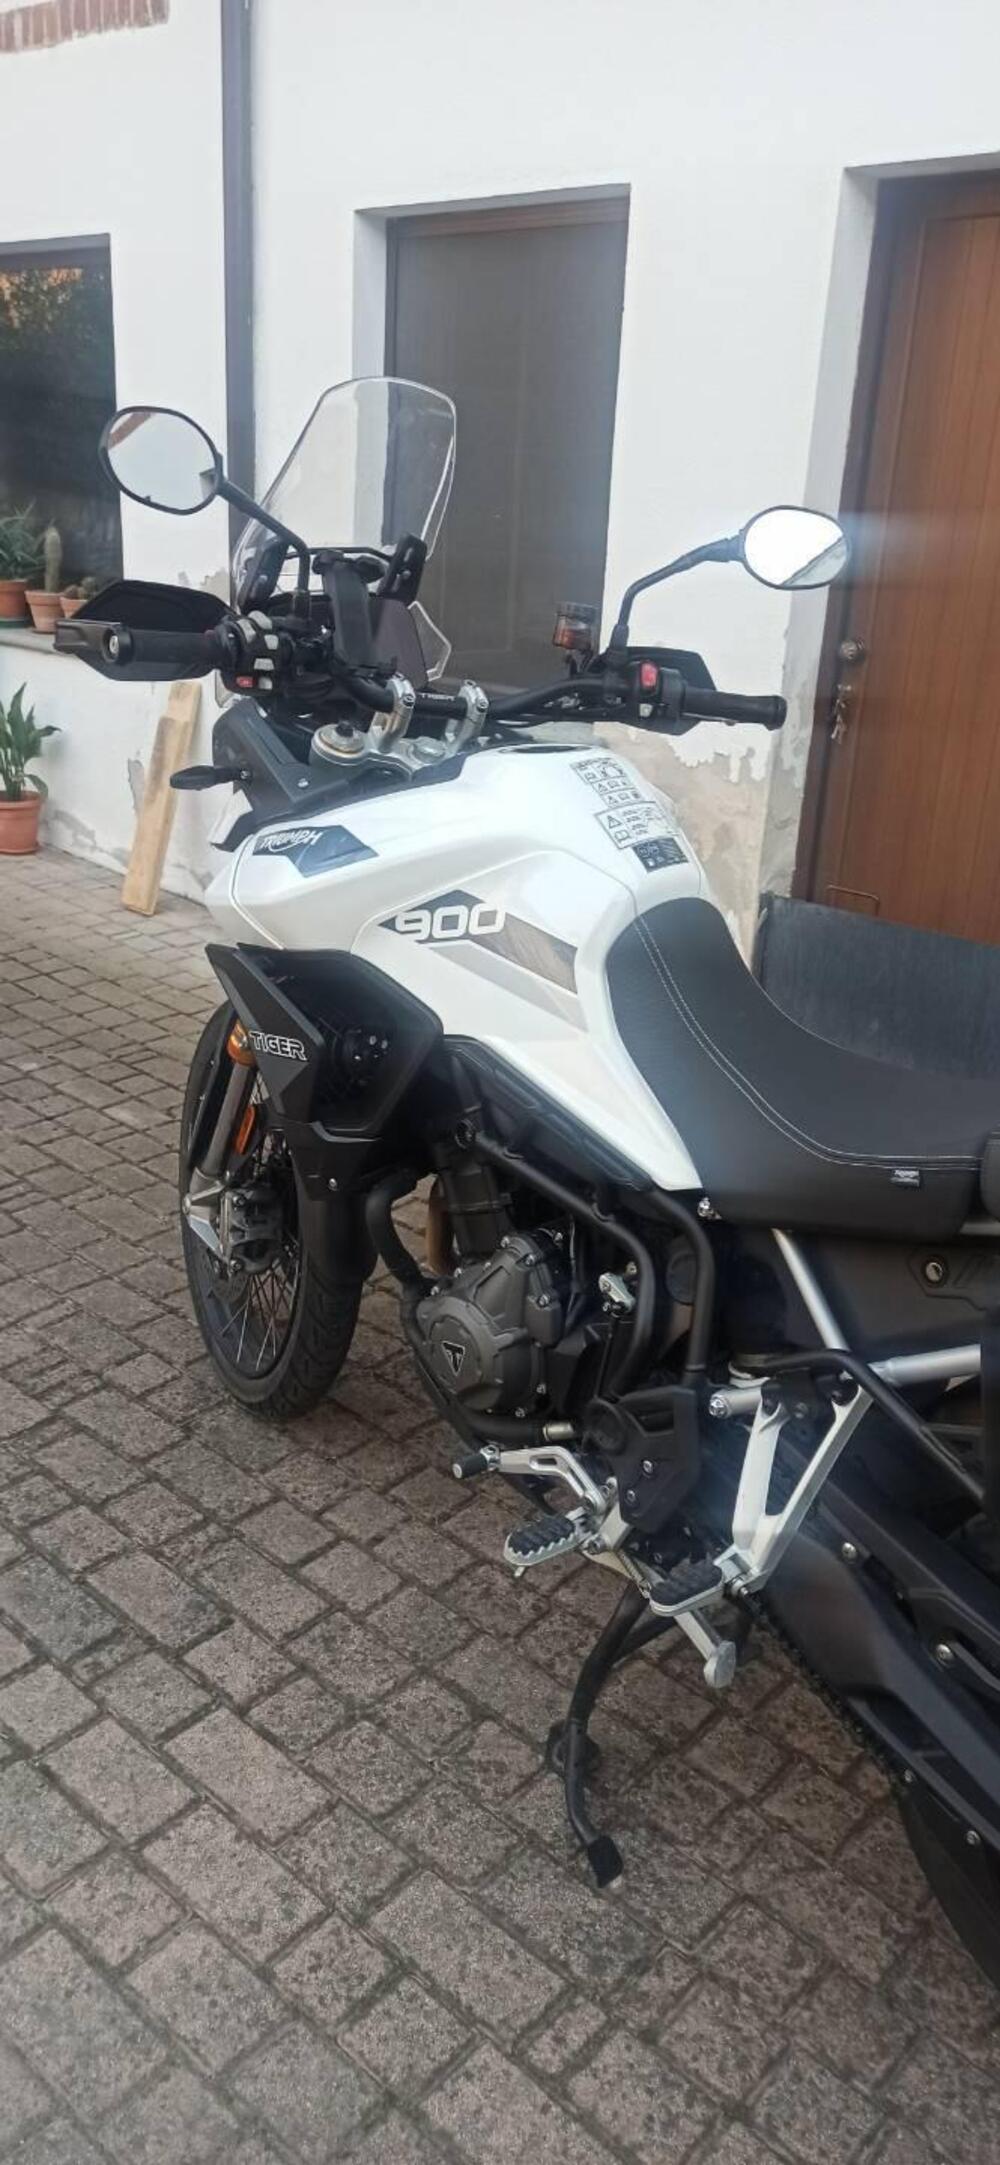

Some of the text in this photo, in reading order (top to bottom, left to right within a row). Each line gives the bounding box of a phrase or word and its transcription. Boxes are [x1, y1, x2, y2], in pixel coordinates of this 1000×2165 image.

[259, 828, 323, 853] TRIUMPH
[395, 902, 506, 941] 900
[248, 1030, 308, 1061] TIGER
